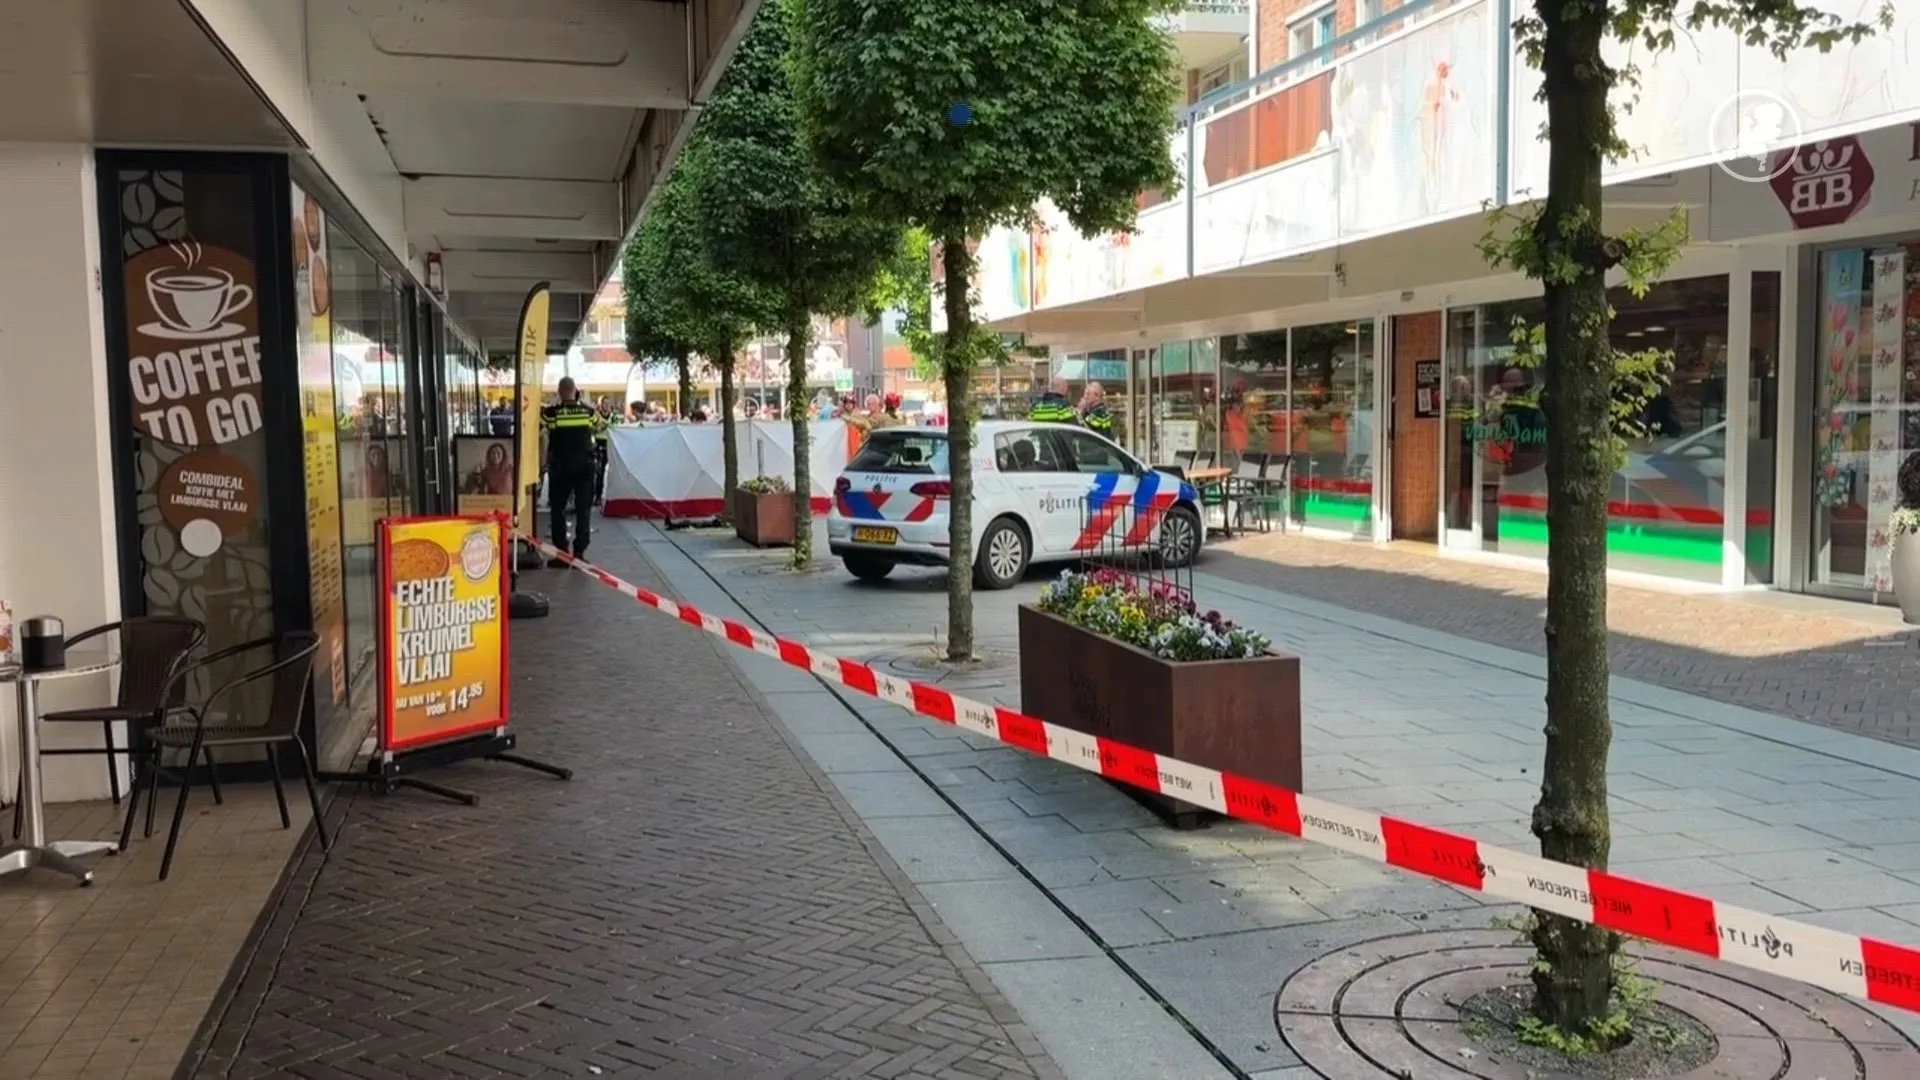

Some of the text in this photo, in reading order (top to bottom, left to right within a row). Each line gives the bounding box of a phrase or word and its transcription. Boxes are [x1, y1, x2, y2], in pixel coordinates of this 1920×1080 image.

[140, 405, 198, 446] TO
[206, 393, 262, 444] GO
[180, 470, 244, 490] COMBIDEAL
[185, 485, 235, 500] KOFFIE MET
[170, 494, 248, 512] LIMBURGSE VLAAI
[396, 575, 455, 606] ECHTE
[396, 594, 496, 633] LIMBURGSE
[397, 624, 476, 659] KRUIMEL
[396, 653, 451, 685] VLAAI
